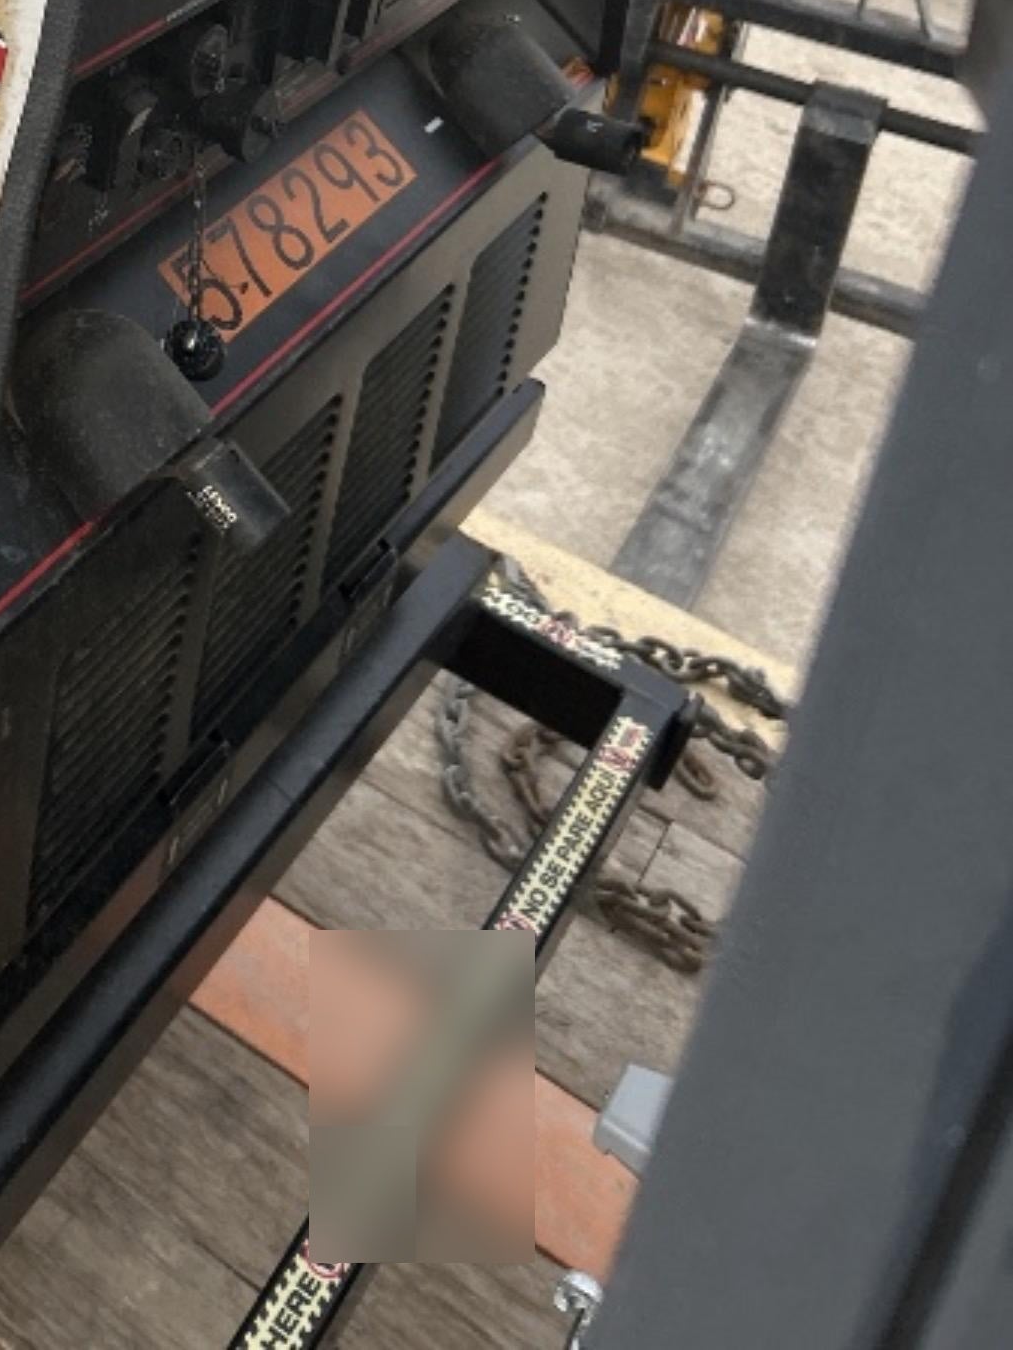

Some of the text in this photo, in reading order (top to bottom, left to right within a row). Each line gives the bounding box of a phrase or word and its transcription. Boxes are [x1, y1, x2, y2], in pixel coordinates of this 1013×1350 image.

[170, 118, 405, 331] 578293
[521, 888, 549, 921] NO
[539, 860, 567, 889] SE
[555, 811, 594, 862] PARE
